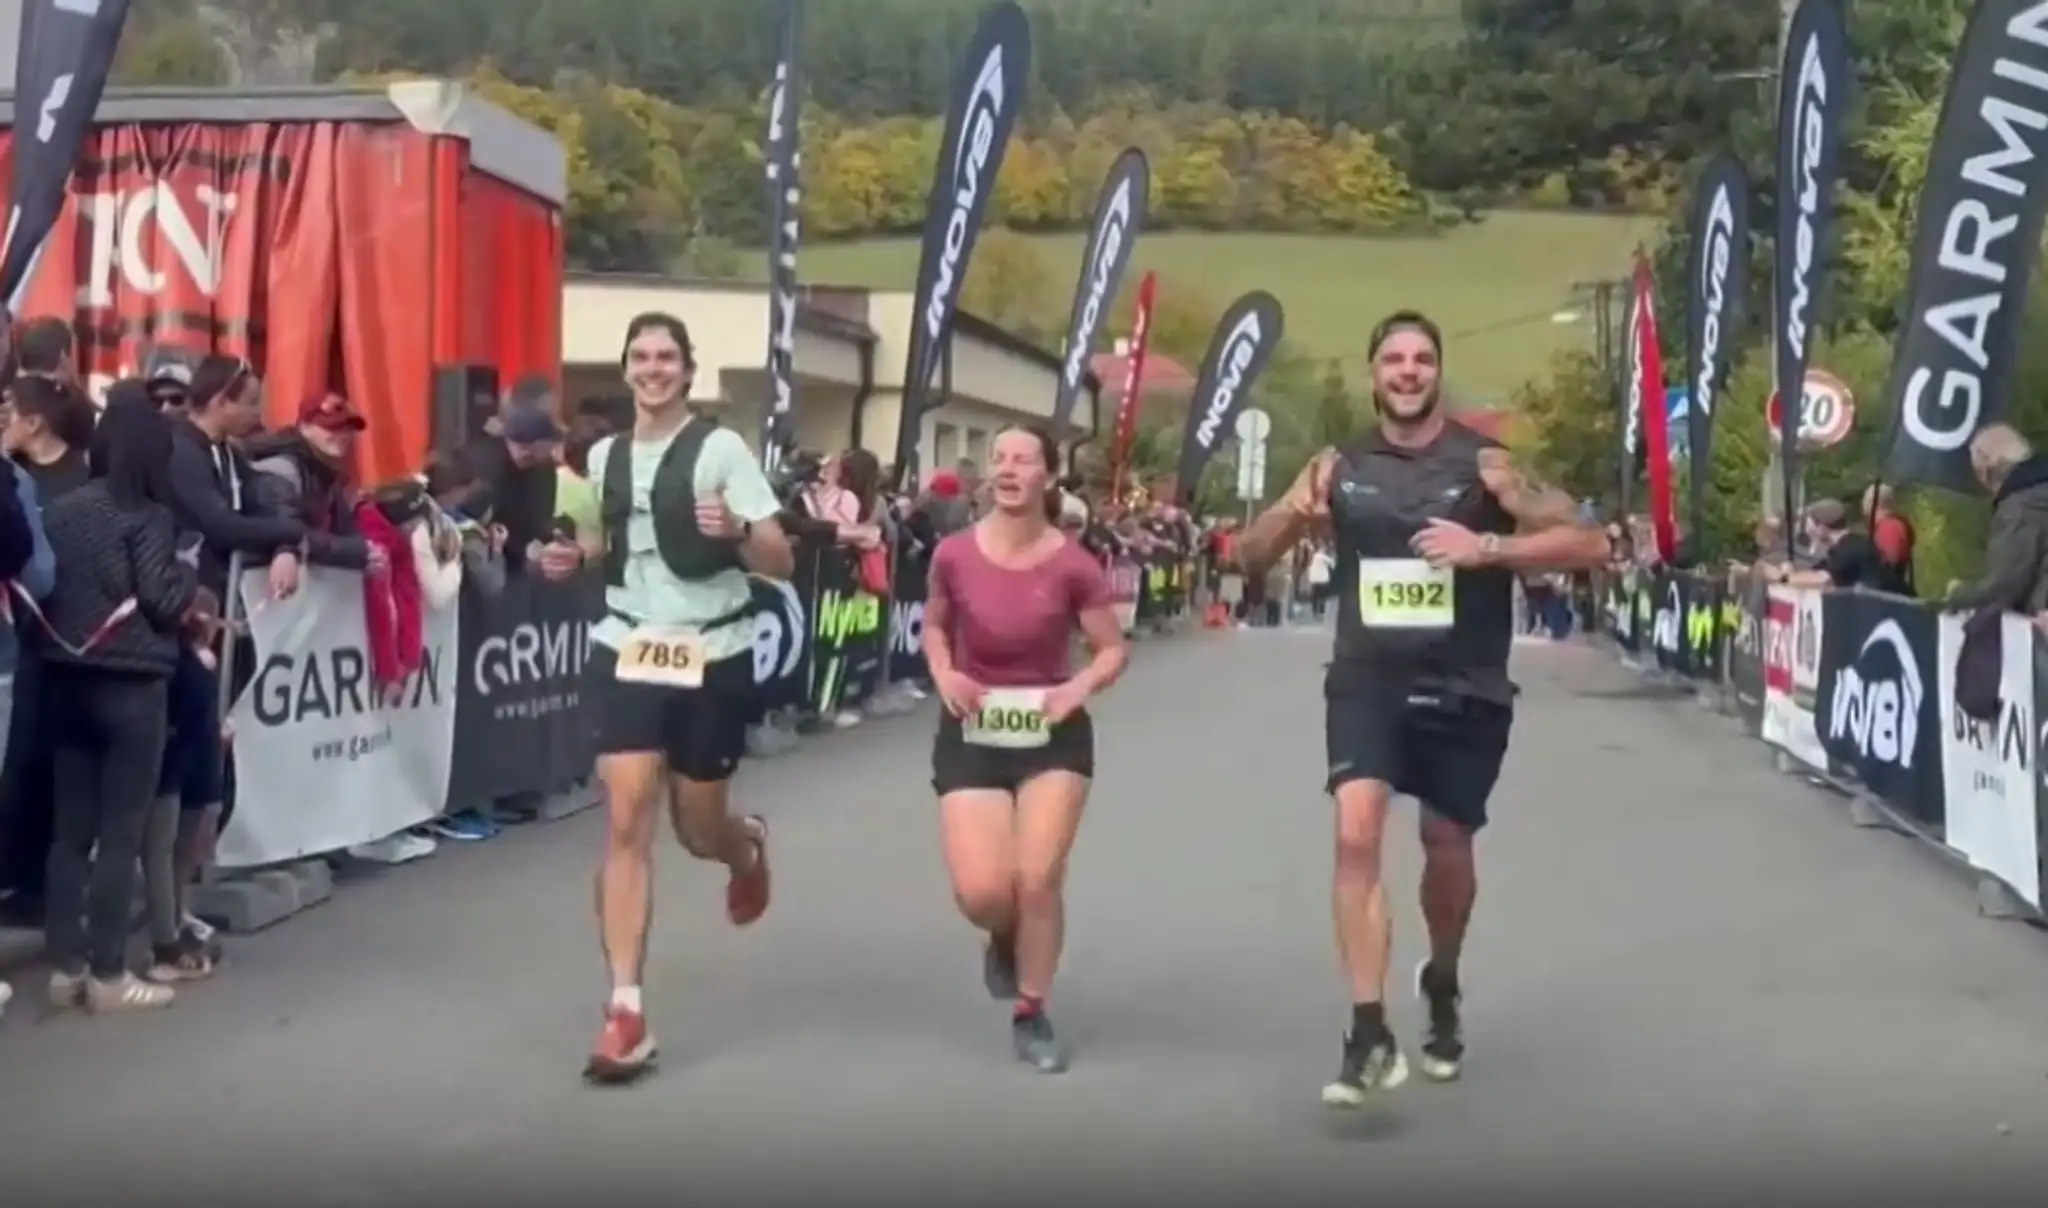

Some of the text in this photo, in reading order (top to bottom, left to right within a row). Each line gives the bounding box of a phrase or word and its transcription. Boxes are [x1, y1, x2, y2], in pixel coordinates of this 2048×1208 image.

[1372, 580, 1445, 608] 1392
[637, 639, 691, 670] 785
[254, 645, 442, 727] GARN
[975, 707, 1042, 733] 1306
